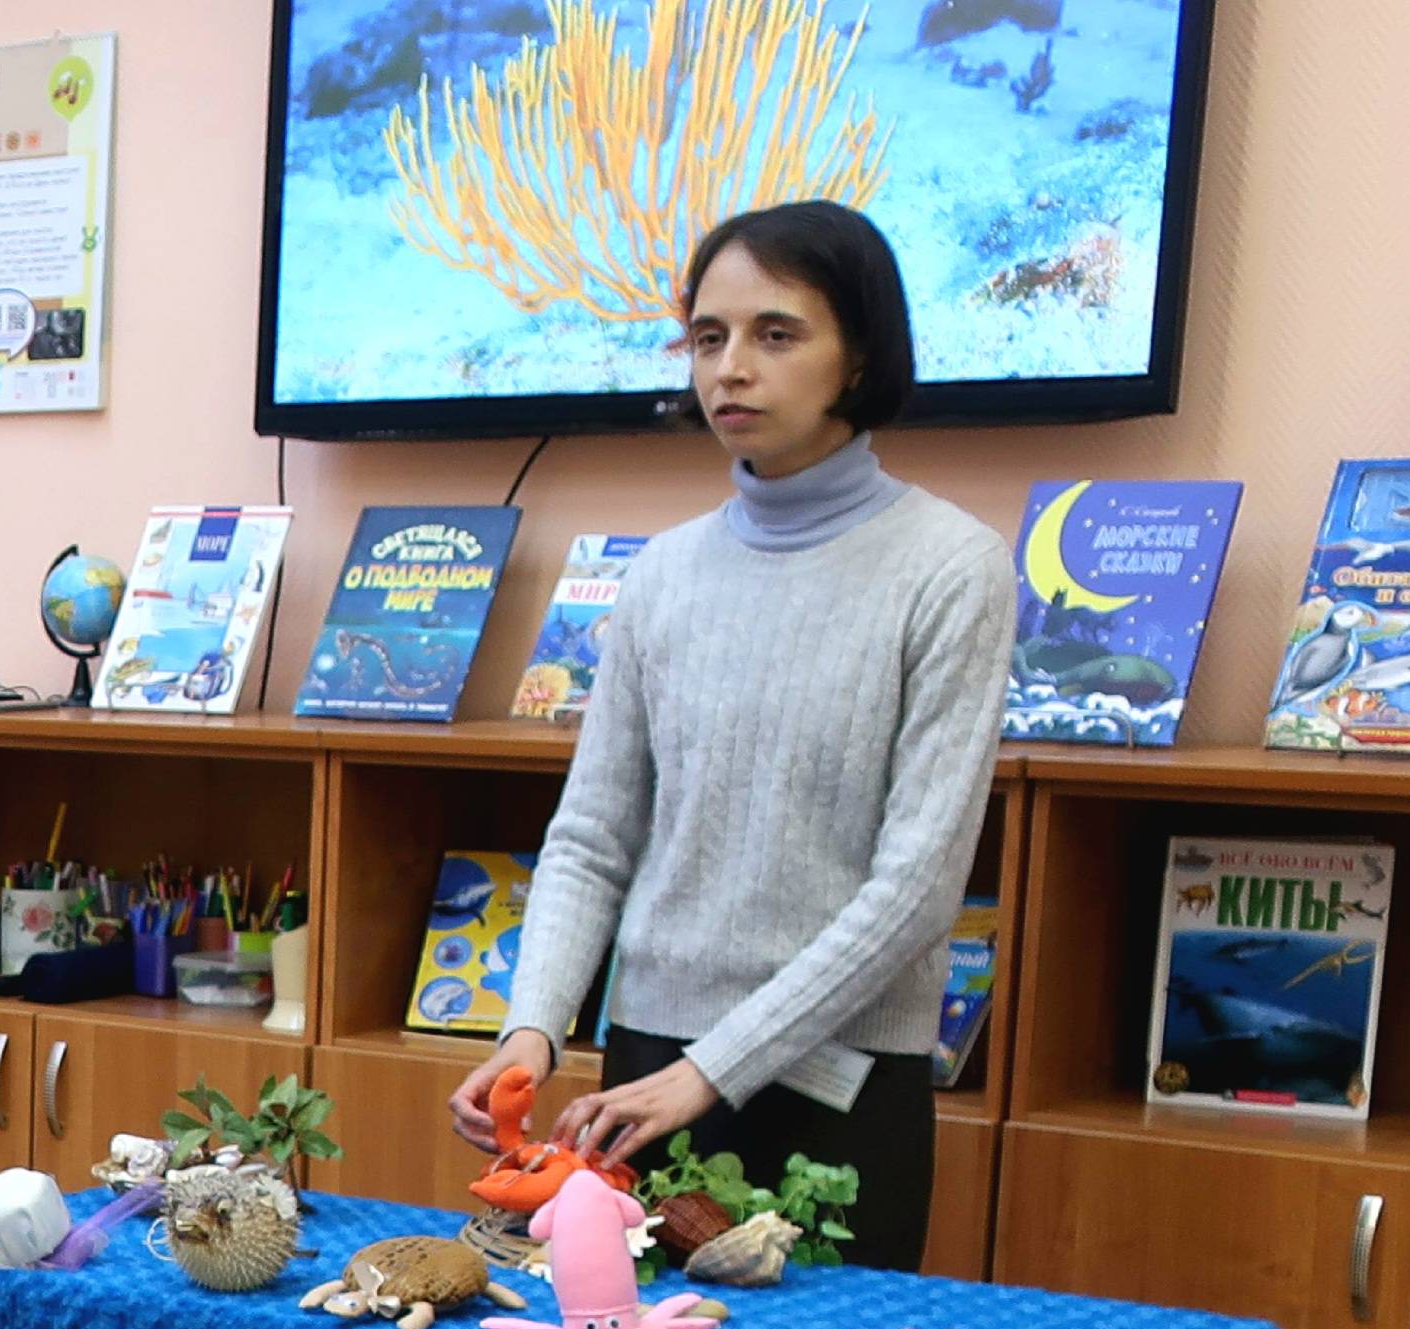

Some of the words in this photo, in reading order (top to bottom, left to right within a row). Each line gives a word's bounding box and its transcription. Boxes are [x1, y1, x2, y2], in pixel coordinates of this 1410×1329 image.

[1092, 525, 1200, 550] МОРСКИЕ
[398, 545, 454, 561] КНИГА
[1100, 550, 1184, 576] СКАЗКИ
[344, 565, 362, 589] О
[364, 563, 494, 591] ПОДВОДНОМ
[383, 589, 439, 612] МИРЕ
[1217, 874, 1343, 932] КИТЫ
